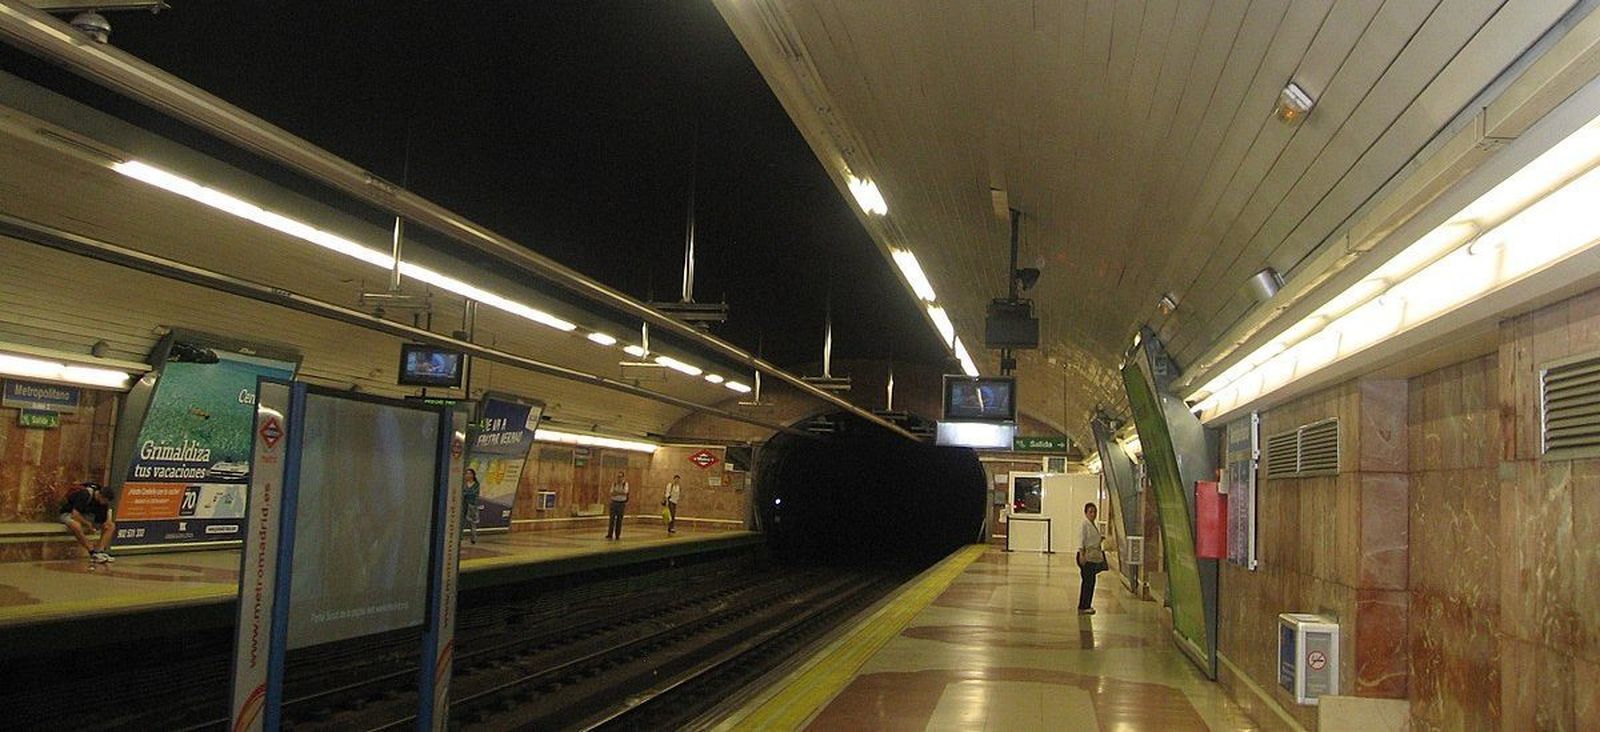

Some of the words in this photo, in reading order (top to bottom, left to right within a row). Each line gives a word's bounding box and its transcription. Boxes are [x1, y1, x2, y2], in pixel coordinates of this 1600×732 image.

[15, 383, 70, 401] Metropolitano
[140, 440, 210, 462] Grimaldiza
[1030, 439, 1053, 448] Salida
[134, 463, 151, 478] tus
[153, 463, 206, 479] vacaciones
[181, 491, 197, 510] 70
[250, 482, 271, 667] www.metromadrid.es
